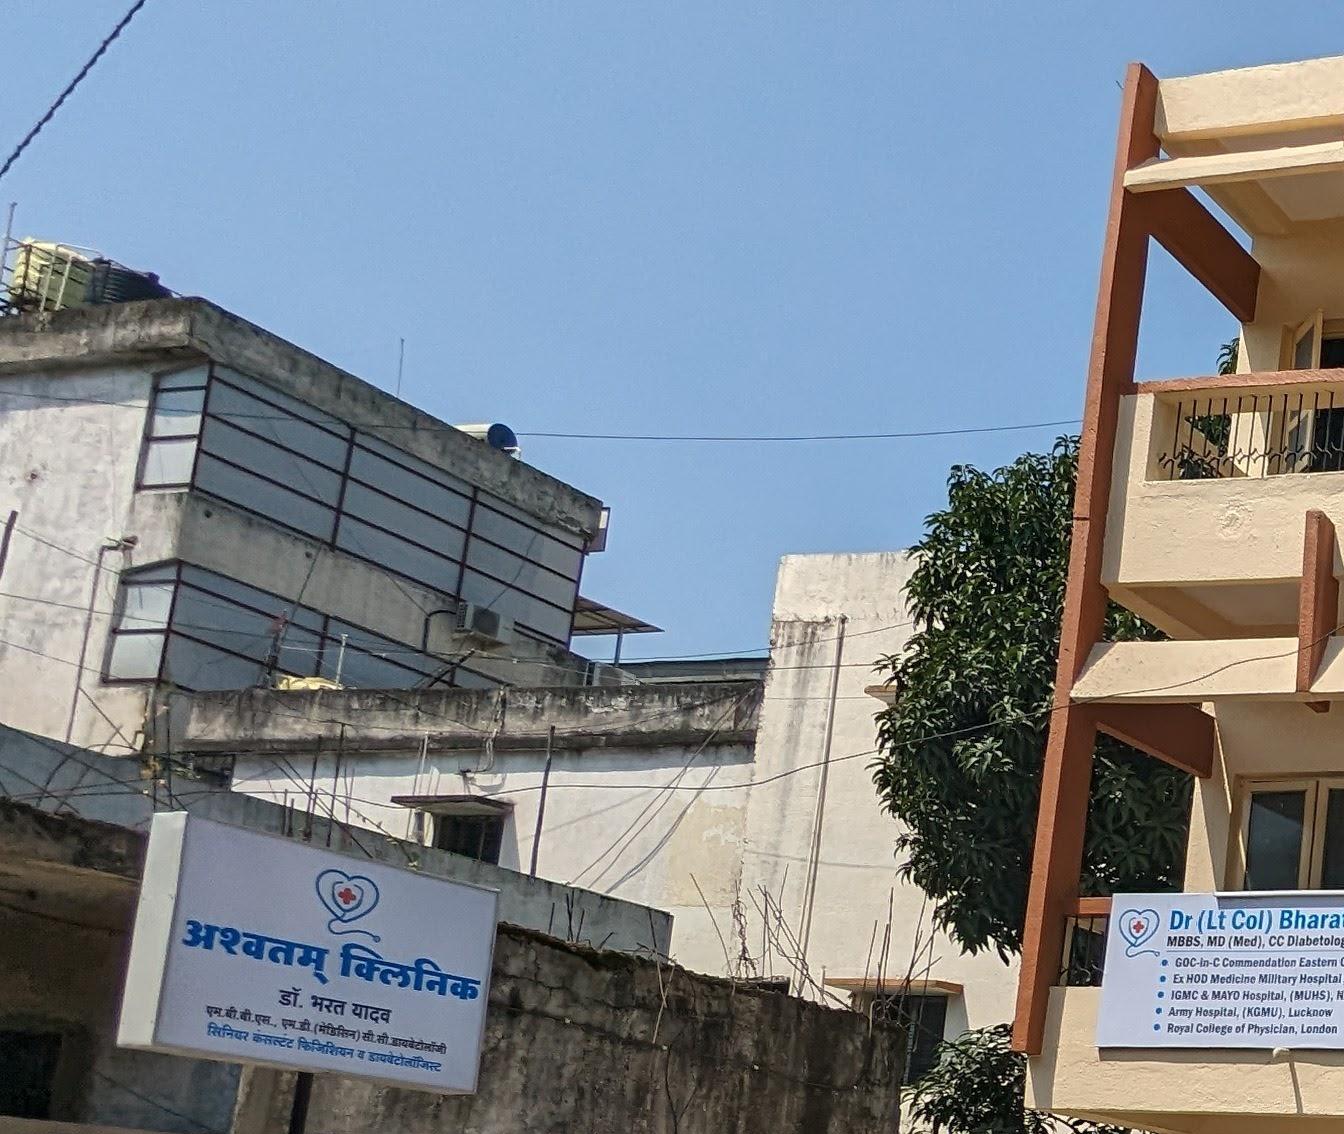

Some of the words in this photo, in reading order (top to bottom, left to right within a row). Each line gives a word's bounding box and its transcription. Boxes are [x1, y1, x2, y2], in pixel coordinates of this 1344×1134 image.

[1169, 909, 1193, 930] Dr
[1198, 909, 1228, 934] (Lt
[1232, 909, 1273, 934] Col)
[1167, 935, 1204, 949] MBBS,
[1207, 936, 1226, 948] MD
[1228, 935, 1266, 949] (Med),
[1269, 936, 1285, 947] CC
[182, 920, 329, 985] अश्वतम्
[340, 943, 481, 1001] क्लिनिक
[1175, 957, 1221, 968] GOC-in-C
[1222, 957, 1297, 968] Commendation
[1299, 957, 1338, 968] Eastern
[1173, 973, 1185, 984] Ex
[1186, 973, 1208, 984] HOD
[1210, 973, 1257, 985] Medicine
[1258, 973, 1297, 986] Military
[1300, 973, 1342, 986] Hospital
[1171, 990, 1199, 1000] IGMC
[1200, 990, 1210, 1001] &
[1212, 990, 1241, 1001] MAYO
[1243, 990, 1287, 1003] Hospital,
[1289, 990, 1334, 1003] (MUHS),
[278, 986, 304, 1009] डॉ.
[311, 994, 347, 1017] भरत
[352, 1002, 392, 1025] यादव
[1168, 1007, 1193, 1018] Army
[1195, 1007, 1240, 1019] Hospital,
[1242, 1007, 1286, 1019] (KGMU),
[1288, 1007, 1333, 1018] Lucknow
[1167, 1023, 1194, 1036] Royal
[1196, 1023, 1233, 1036] College
[1235, 1023, 1246, 1034] of
[1247, 1023, 1298, 1036] Physician,
[1300, 1023, 1338, 1035] London
